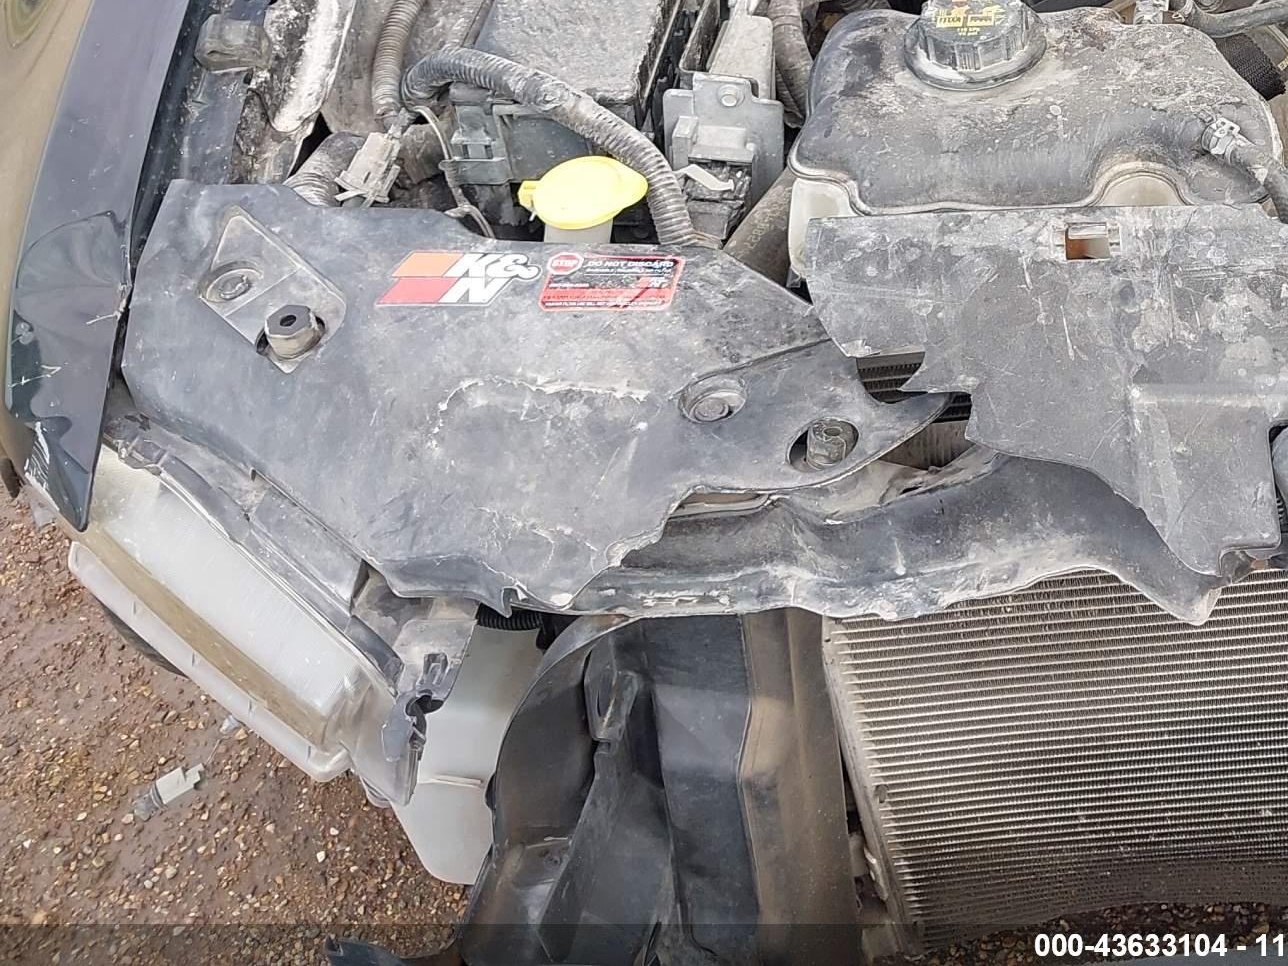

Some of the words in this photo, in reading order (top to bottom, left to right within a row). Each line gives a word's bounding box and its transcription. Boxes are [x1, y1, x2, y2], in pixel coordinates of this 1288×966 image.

[552, 259, 577, 268] STOP
[587, 260, 604, 268] DO
[604, 260, 625, 268] NOT
[628, 260, 674, 268] DISCARD
